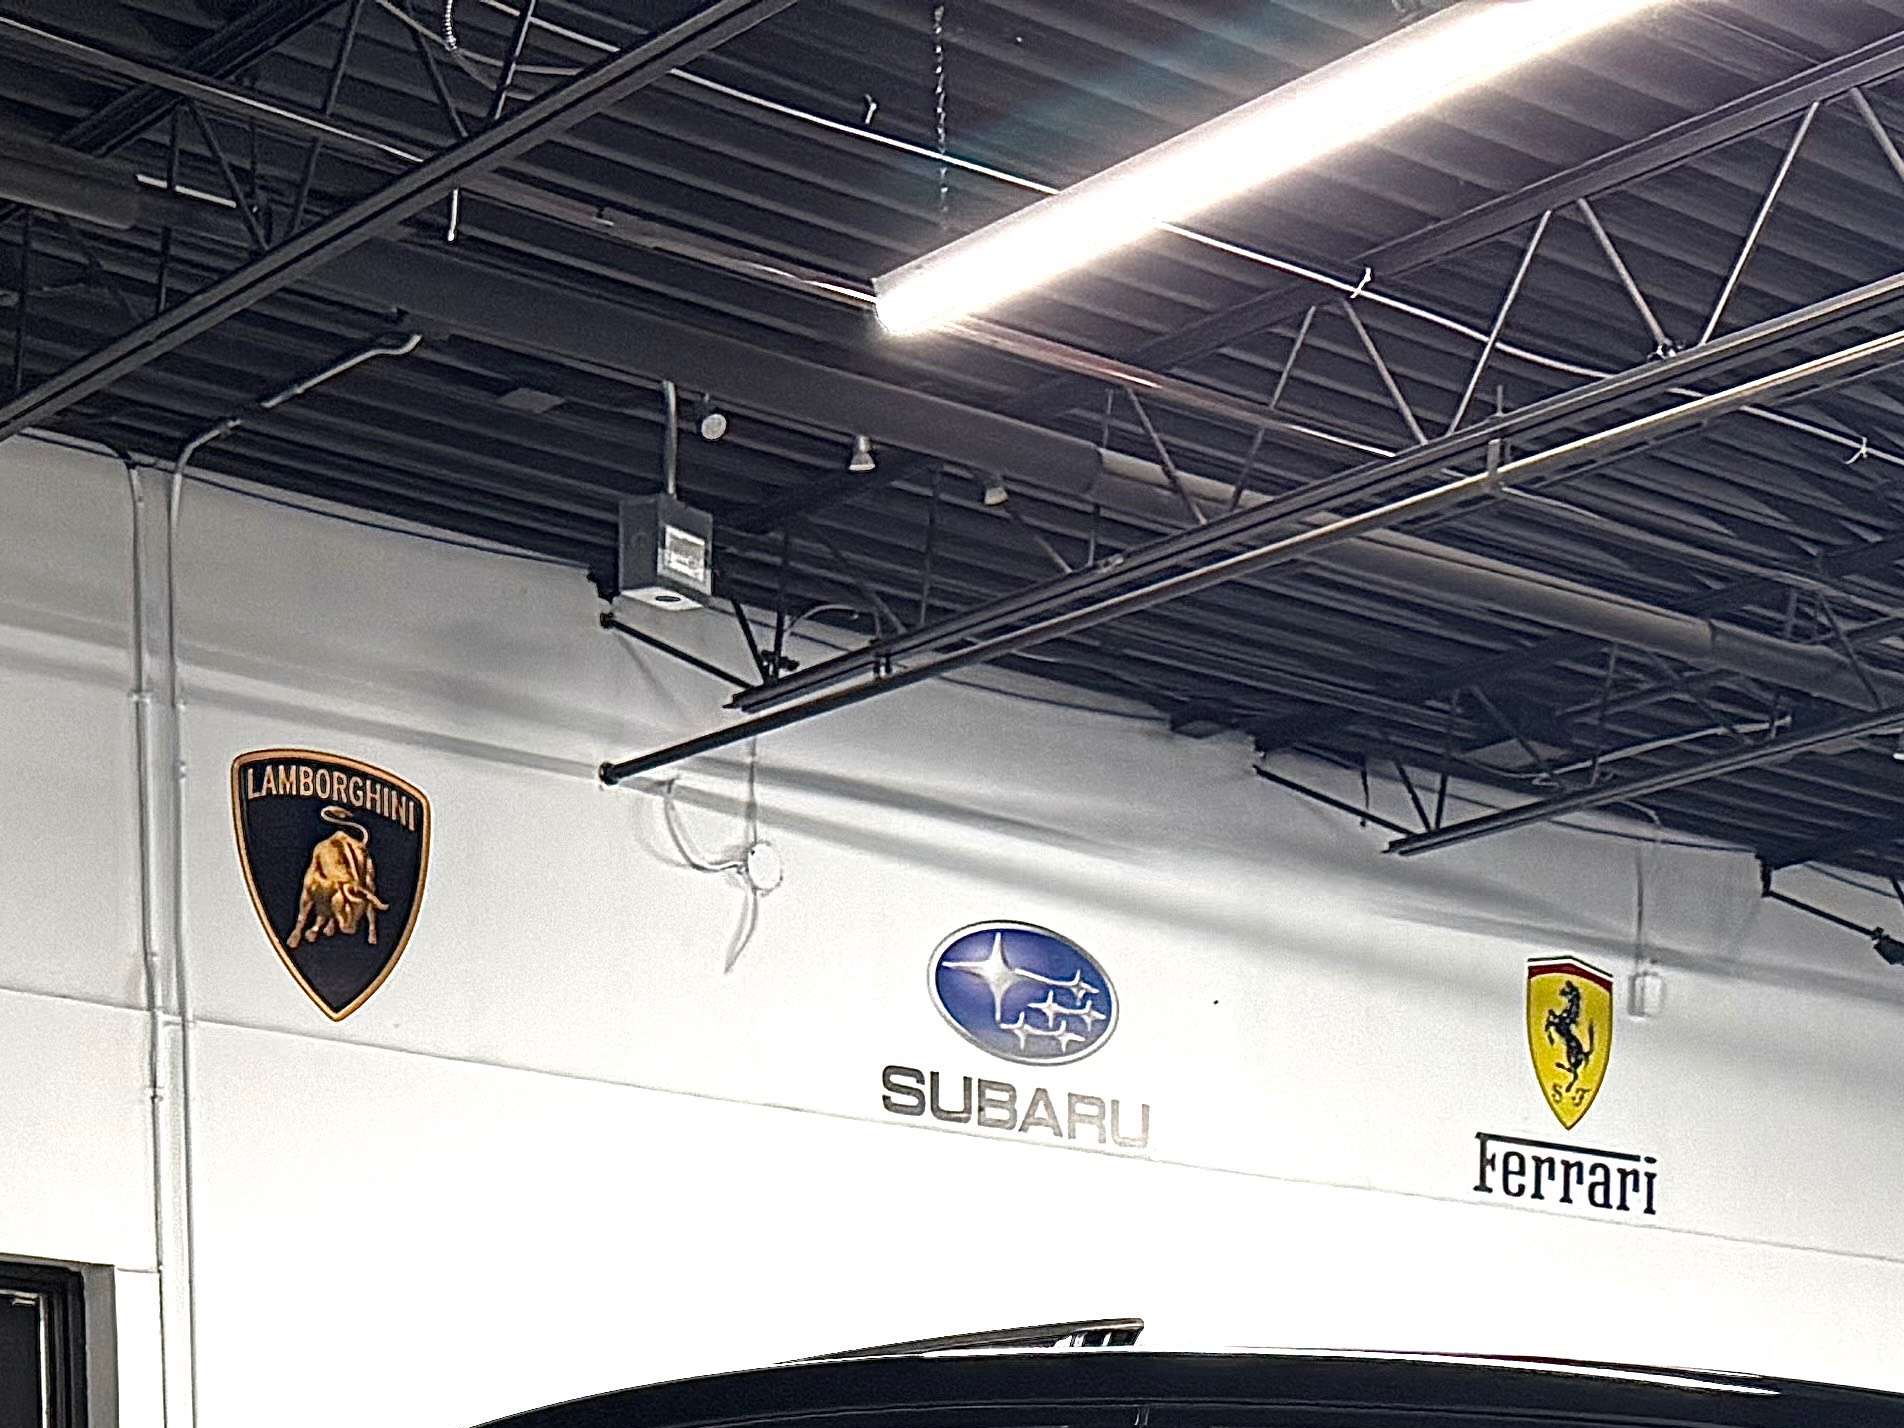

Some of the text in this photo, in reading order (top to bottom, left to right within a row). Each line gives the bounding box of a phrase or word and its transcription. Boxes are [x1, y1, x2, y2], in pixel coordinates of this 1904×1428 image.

[246, 764, 416, 832] LAMBORGHINI
[881, 1065, 1152, 1149] SUBARU
[1551, 1083, 1563, 1104] S
[1472, 1131, 1658, 1216] Ferrari
